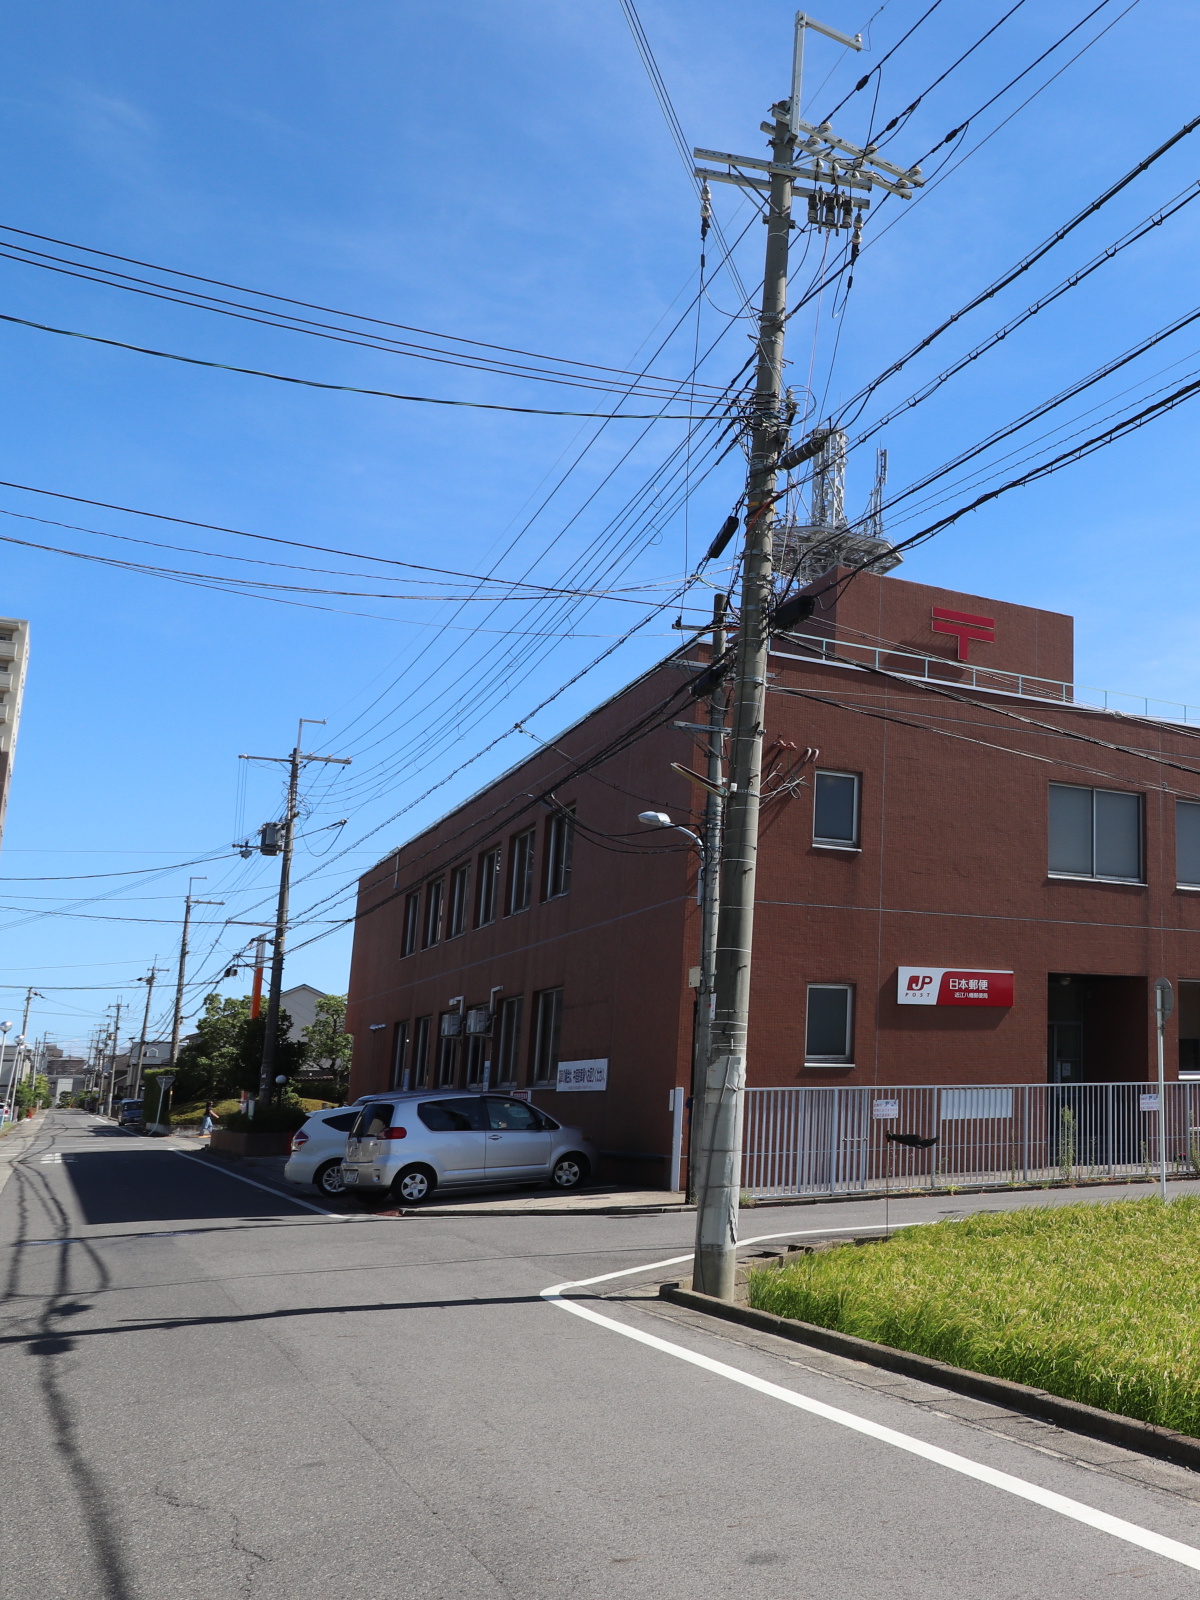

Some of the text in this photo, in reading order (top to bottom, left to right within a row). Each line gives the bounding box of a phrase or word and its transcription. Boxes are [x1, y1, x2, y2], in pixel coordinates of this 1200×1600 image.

[907, 975, 933, 991] JP
[950, 979, 988, 990] 日本郵便
